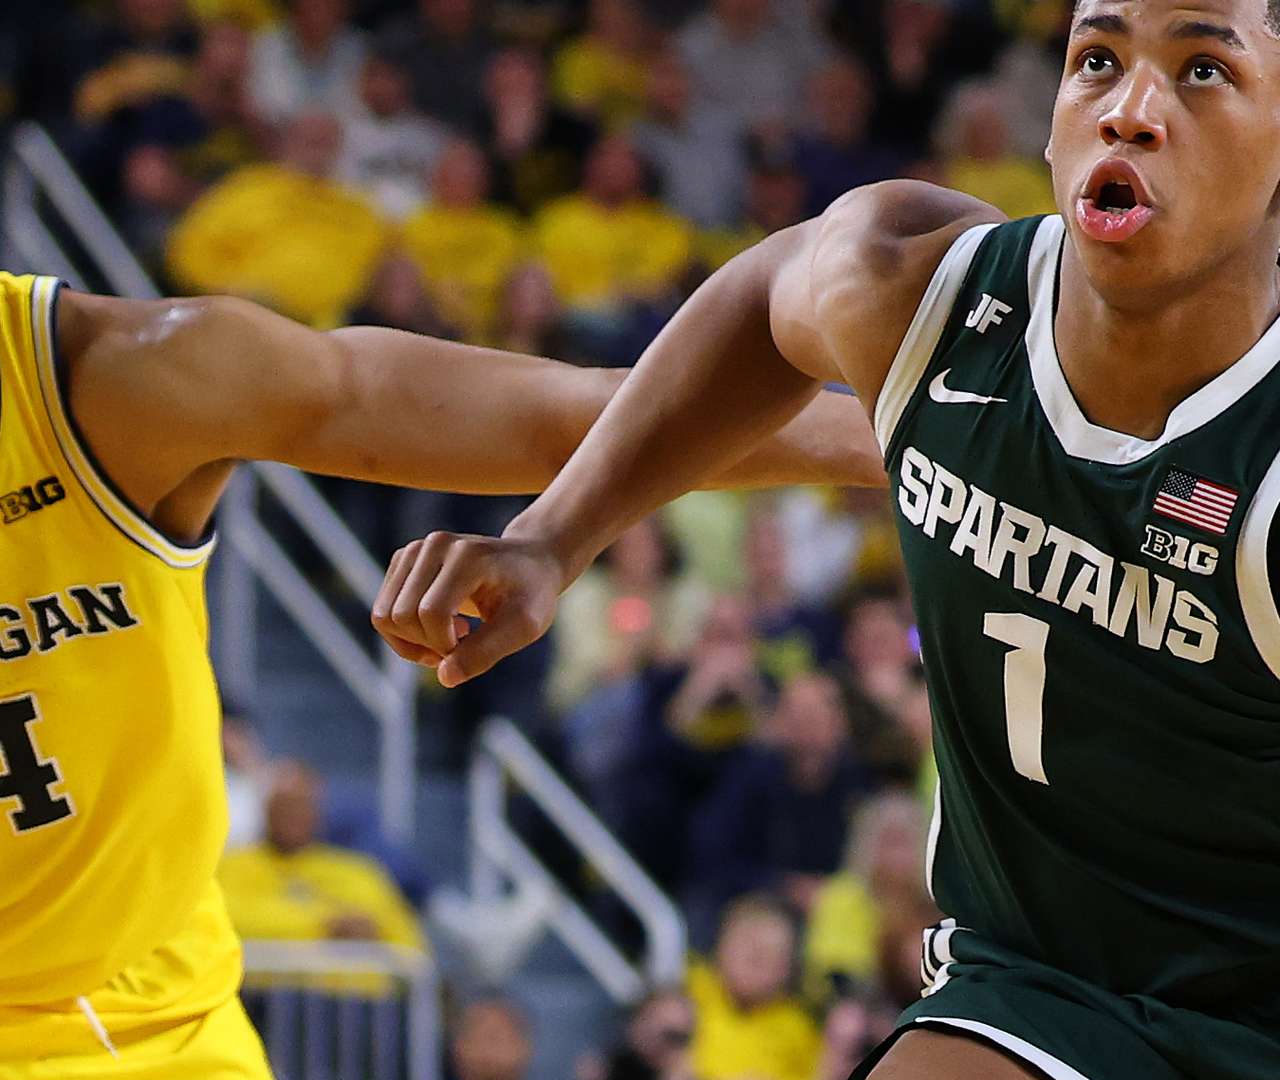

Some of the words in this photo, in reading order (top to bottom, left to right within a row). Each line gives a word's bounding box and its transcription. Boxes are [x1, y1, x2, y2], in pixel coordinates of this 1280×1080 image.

[964, 292, 1014, 335] JF
[897, 445, 1220, 665] SPARTANS
[983, 612, 1051, 786] 1
